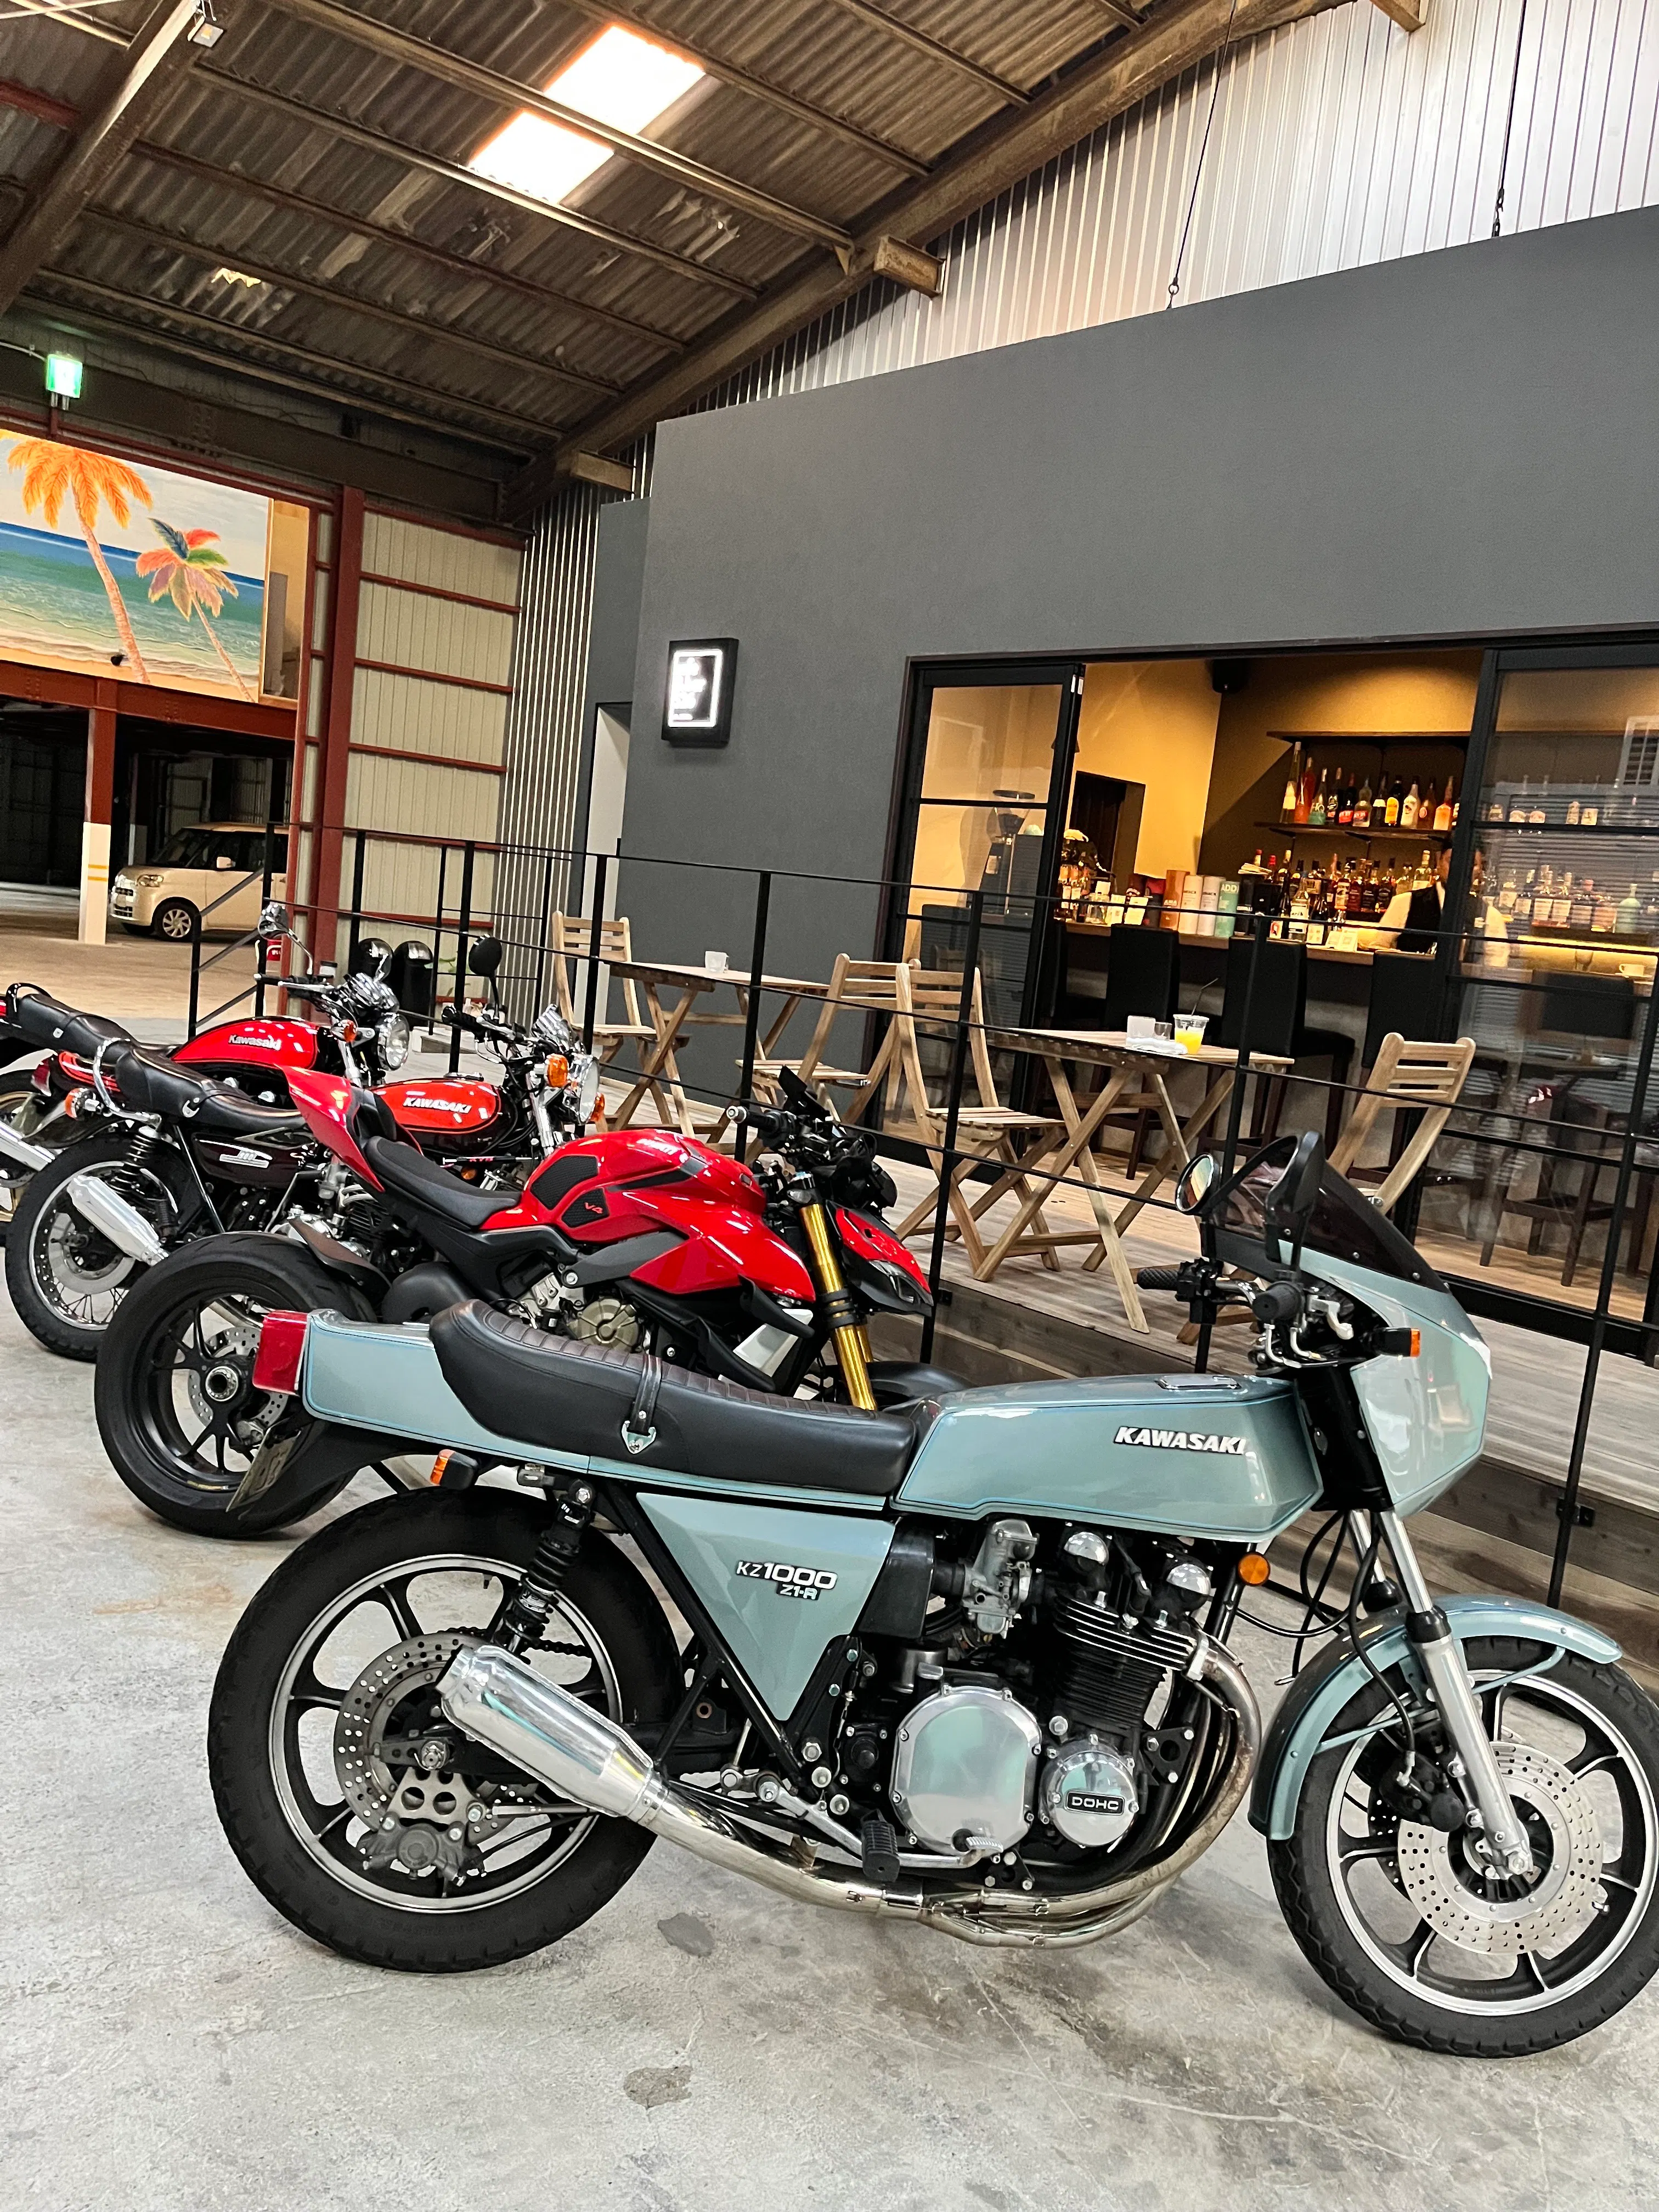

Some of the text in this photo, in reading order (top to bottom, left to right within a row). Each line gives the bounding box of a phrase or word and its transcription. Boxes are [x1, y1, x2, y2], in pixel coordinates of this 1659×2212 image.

[228, 1034, 281, 1051] Kawasaki
[403, 1097, 472, 1114] KAWASAKI
[1114, 1426, 1247, 1455] KAWASAKI
[736, 1560, 838, 1590] KZ1000
[1071, 1796, 1119, 1810] DOHC
